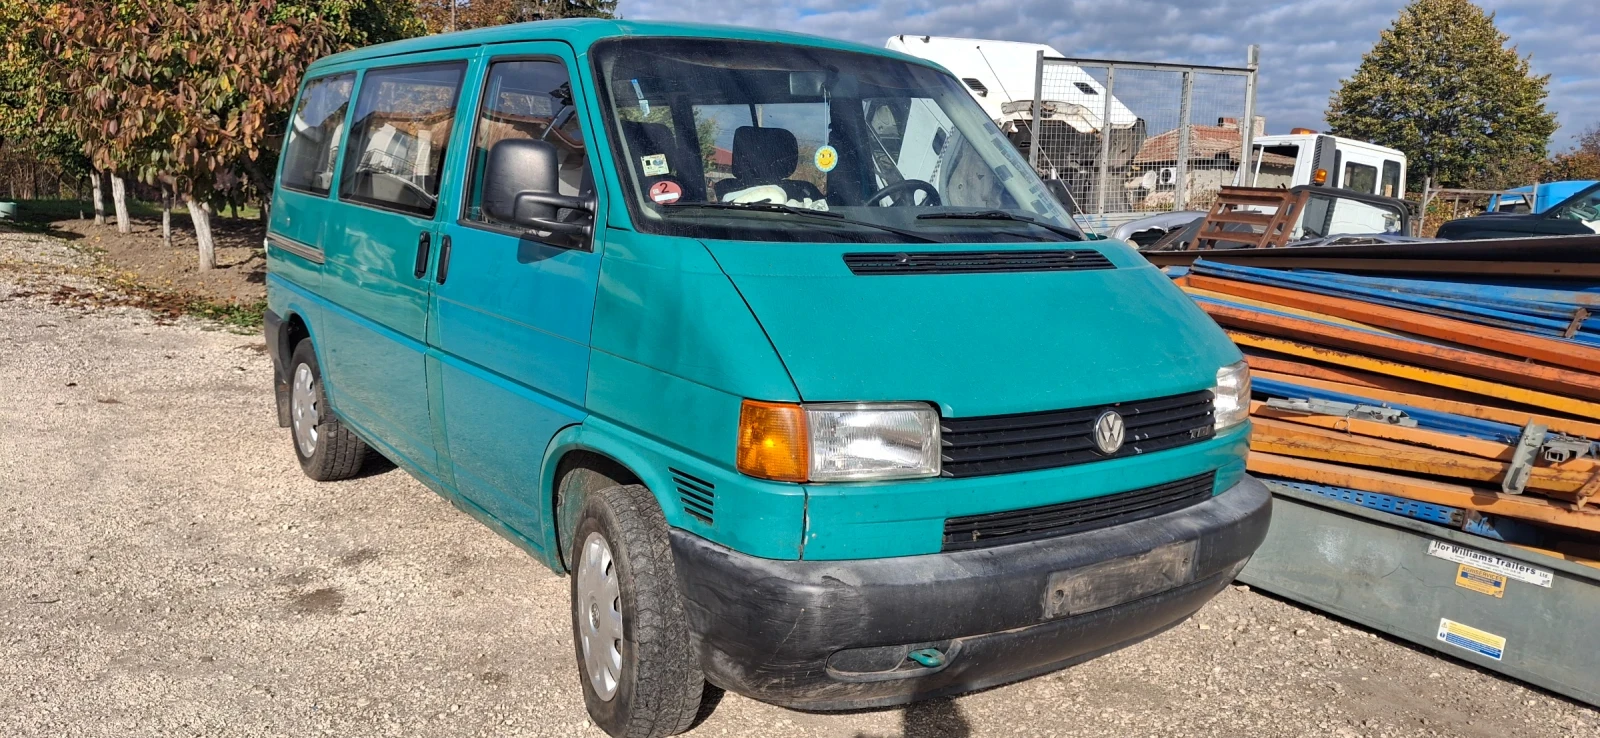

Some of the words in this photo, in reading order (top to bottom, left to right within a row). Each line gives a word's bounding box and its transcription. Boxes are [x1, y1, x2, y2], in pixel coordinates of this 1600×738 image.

[659, 182, 670, 194] 2
[1451, 545, 1493, 564] Williams
[1495, 557, 1536, 574] Trailers
